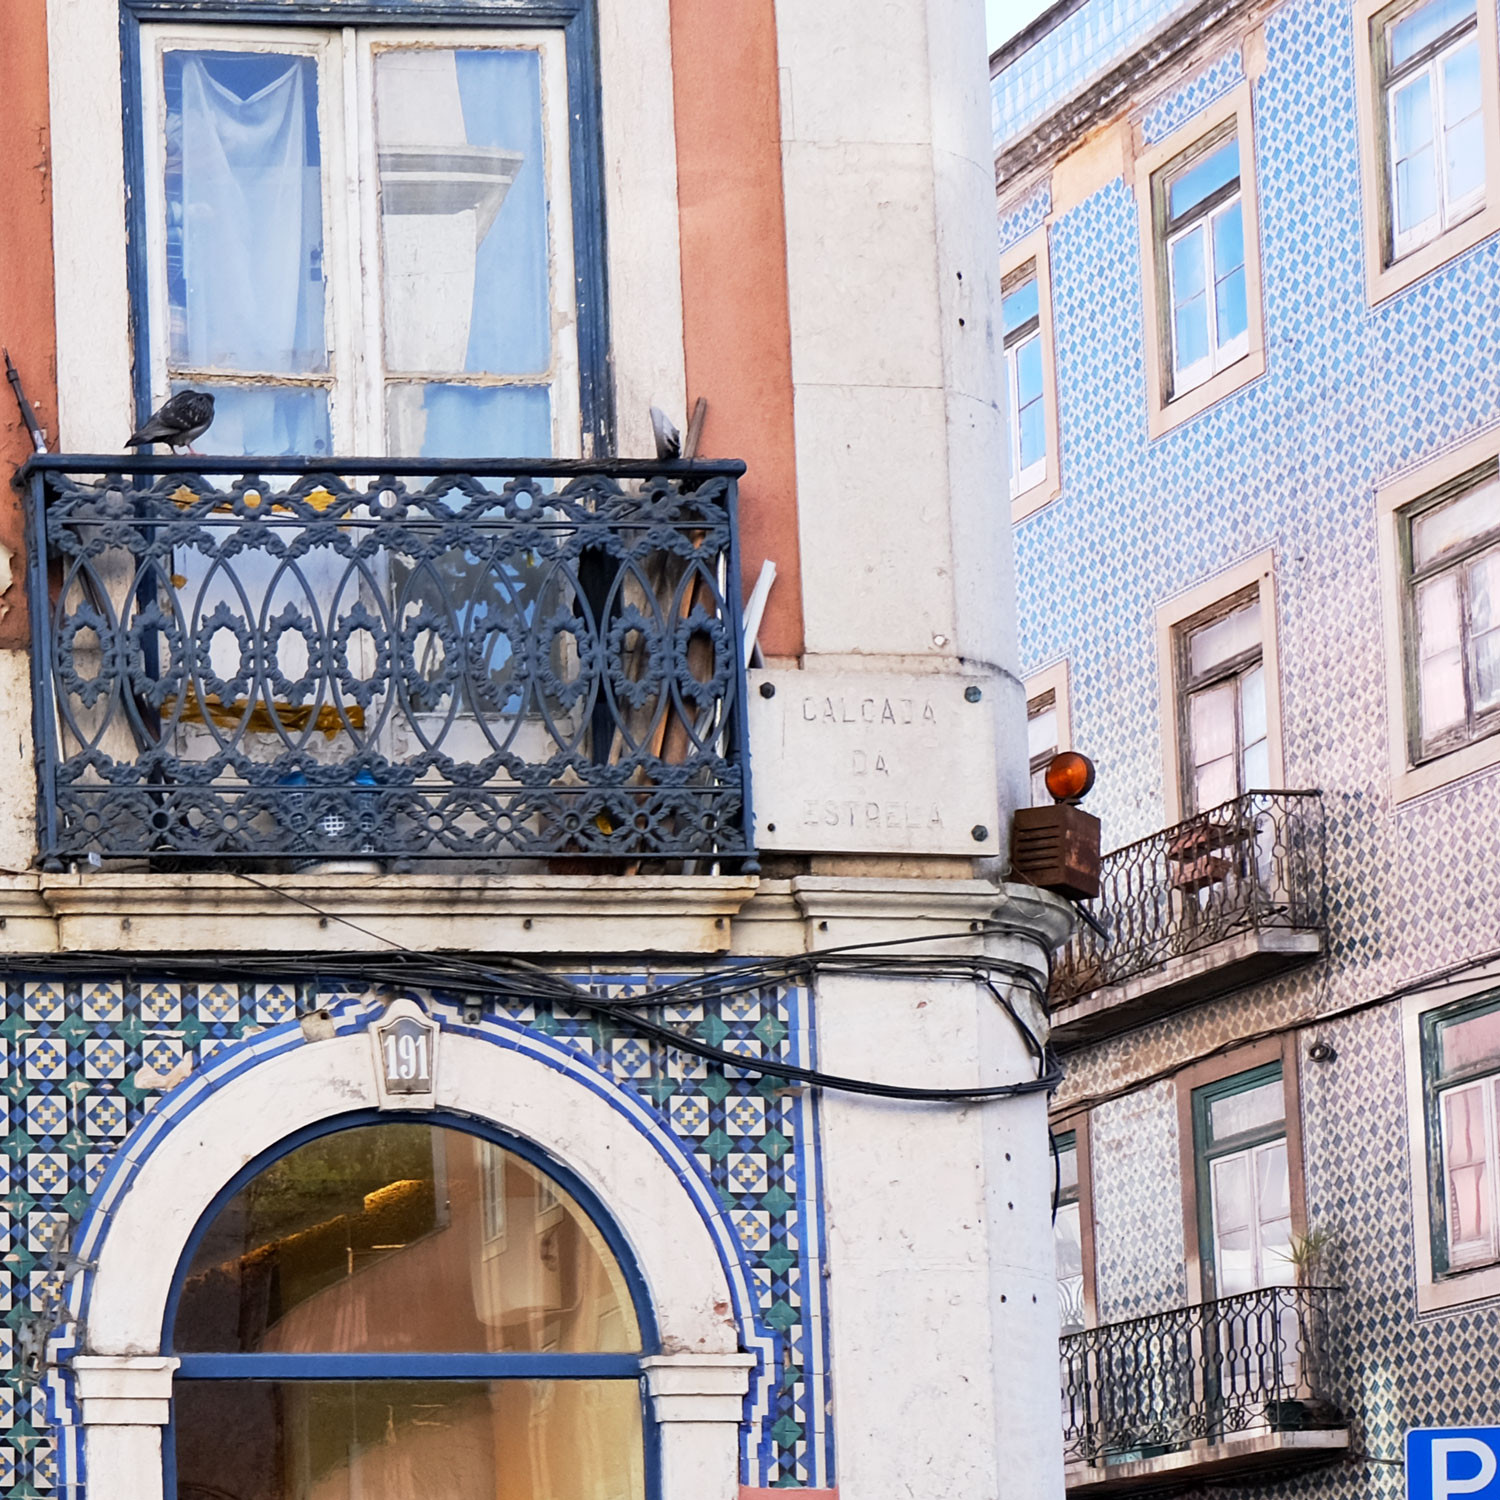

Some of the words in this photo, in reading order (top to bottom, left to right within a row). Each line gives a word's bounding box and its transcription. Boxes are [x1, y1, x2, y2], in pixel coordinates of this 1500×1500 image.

[852, 749, 889, 776] DA
[802, 799, 944, 829] ESTRELA
[383, 1034, 429, 1080] 191
